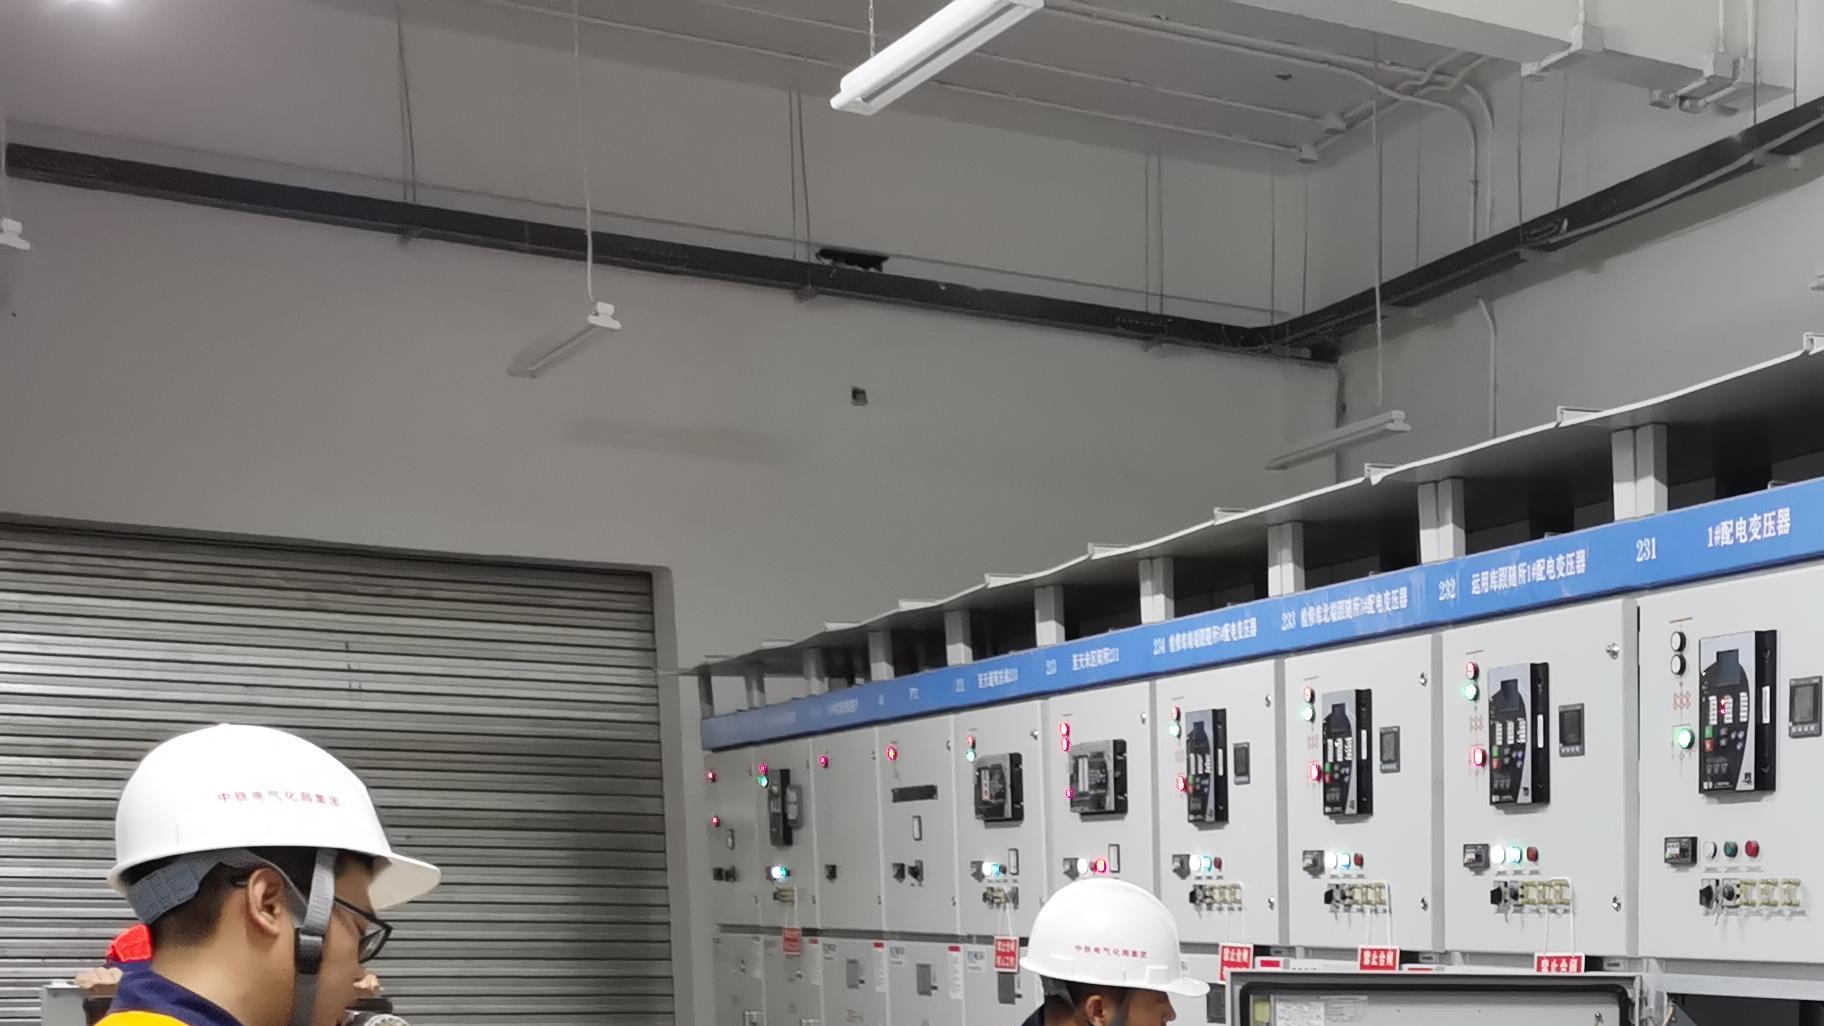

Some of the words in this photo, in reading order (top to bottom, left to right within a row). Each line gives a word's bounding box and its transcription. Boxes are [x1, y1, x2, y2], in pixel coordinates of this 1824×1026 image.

[1636, 537, 1657, 562] 231
[1707, 507, 1791, 548] 1#配电变压器
[1439, 578, 1456, 601] 232
